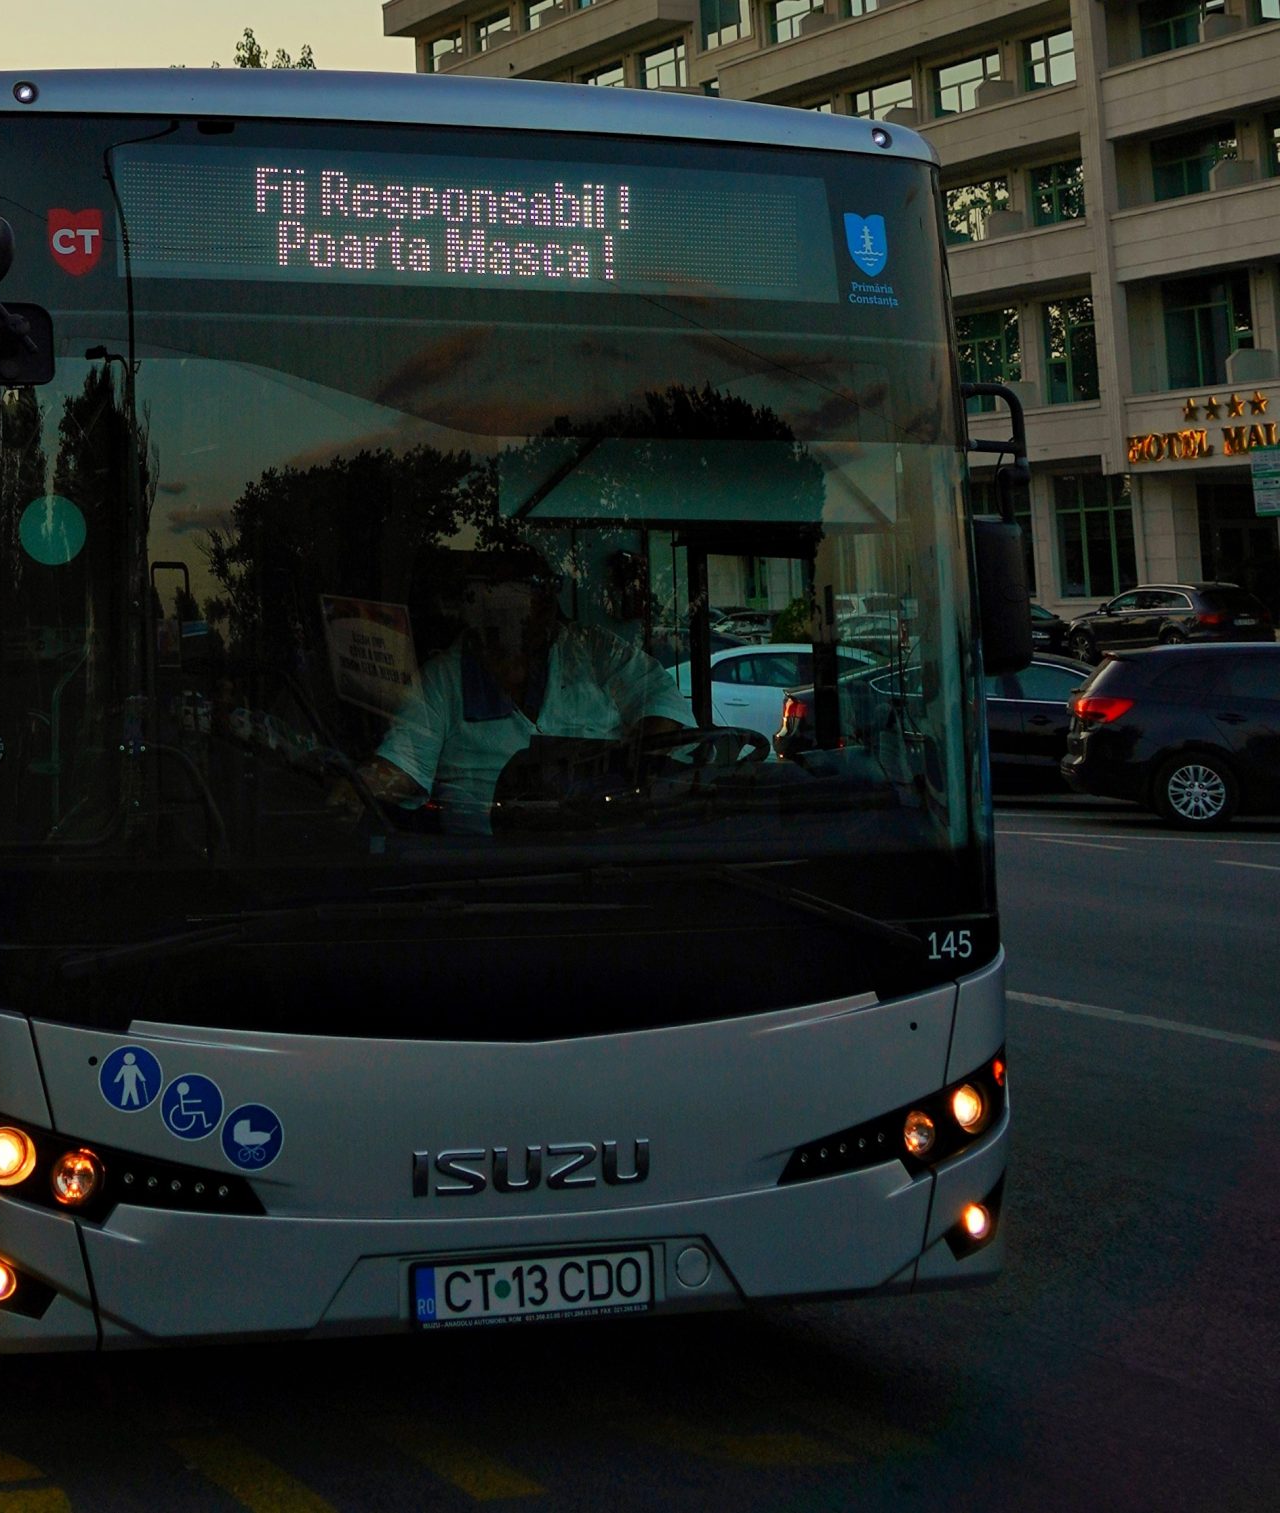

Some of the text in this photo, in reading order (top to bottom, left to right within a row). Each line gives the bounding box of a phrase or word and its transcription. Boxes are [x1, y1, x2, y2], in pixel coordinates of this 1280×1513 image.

[256, 167, 305, 215] Fii
[52, 228, 100, 255] CT
[278, 220, 431, 272] Poarta
[1127, 427, 1214, 464] HOTEL
[927, 929, 973, 960] 145
[412, 1138, 650, 1198] ISUZU
[559, 1257, 642, 1302] CDO
[417, 1297, 435, 1316] RO
